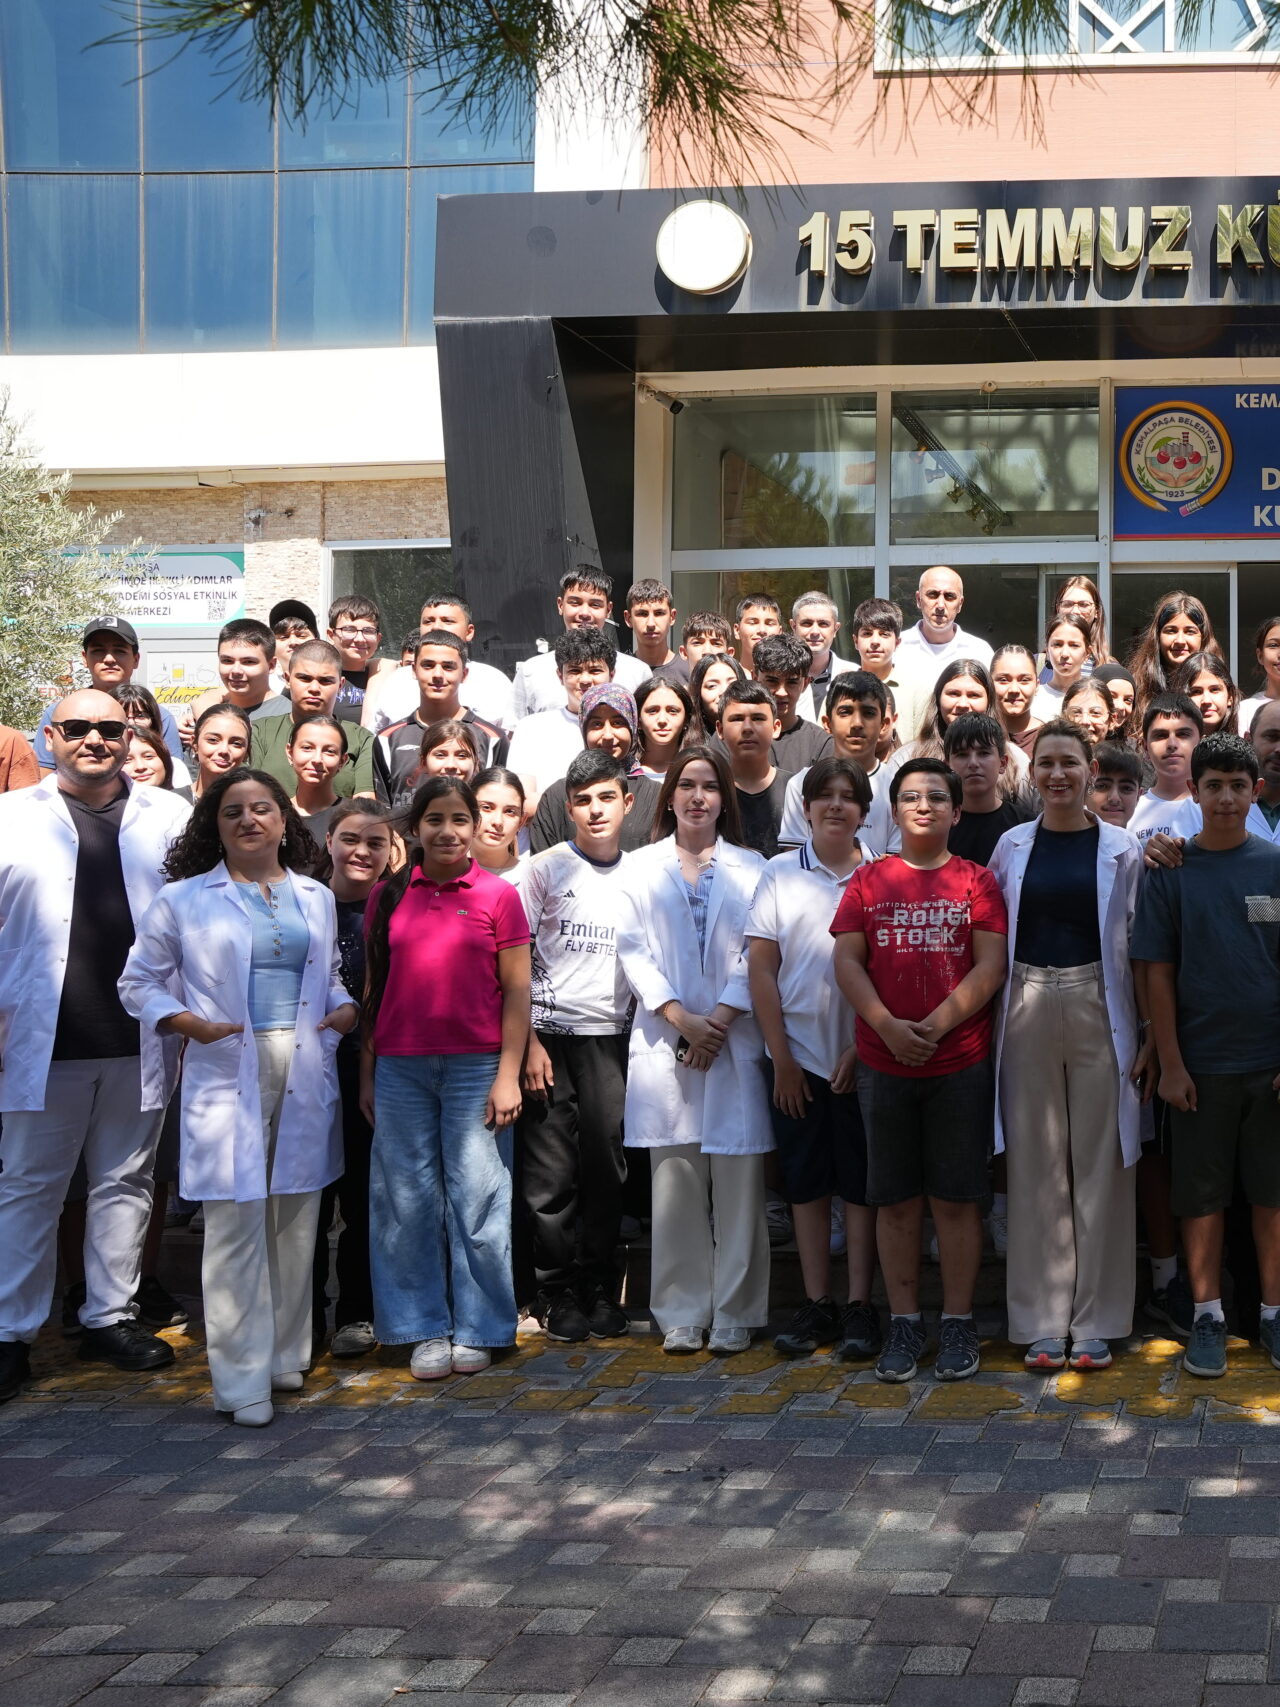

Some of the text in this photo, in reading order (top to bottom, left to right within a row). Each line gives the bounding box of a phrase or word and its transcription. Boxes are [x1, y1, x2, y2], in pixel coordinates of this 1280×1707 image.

[799, 210, 875, 275] 15
[893, 205, 1193, 272] TEMMUZ
[1134, 416, 1219, 456] KEMALPAŞA BELEDİYESİ
[1164, 490, 1185, 498] 1923
[153, 591, 191, 601] SOSYAL
[193, 588, 238, 600] ETKİNLİK
[1136, 828, 1154, 839] NEW
[893, 908, 972, 927] ROUGH
[877, 927, 956, 947] STOCK
[564, 940, 585, 952] FLY
